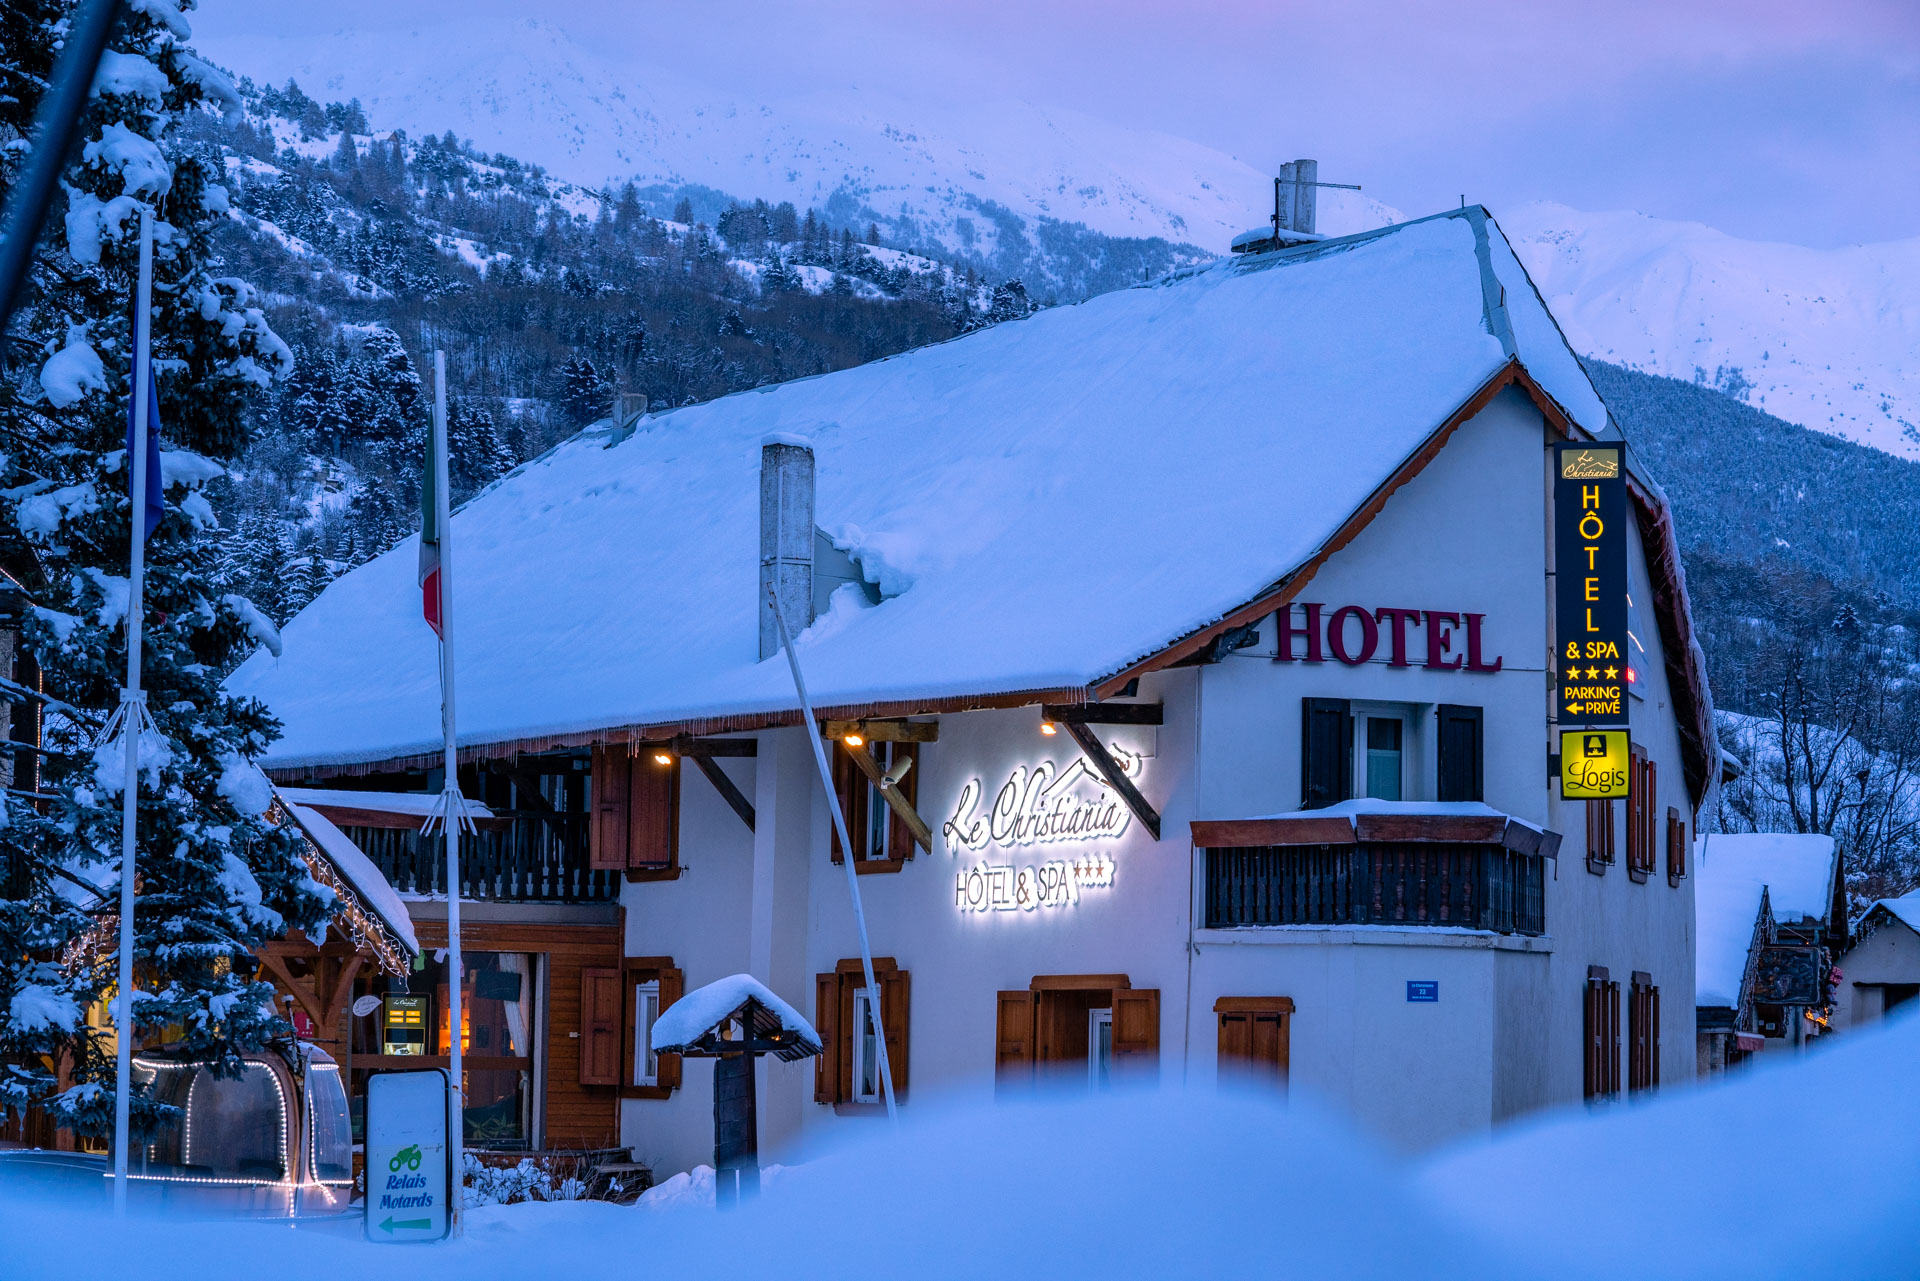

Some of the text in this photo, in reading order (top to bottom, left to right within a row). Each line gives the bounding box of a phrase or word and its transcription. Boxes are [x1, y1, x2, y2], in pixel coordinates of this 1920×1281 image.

[1577, 450, 1593, 462] Le
[1563, 463, 1614, 478] Christiania
[1579, 485, 1604, 632] HÔTEL
[1272, 602, 1503, 672] HOTEL
[1566, 641, 1620, 659] & SPA
[1565, 686, 1620, 699] PARKING
[1586, 699, 1620, 714] PRIVÉ
[1566, 759, 1625, 793] Logis
[943, 766, 1121, 848] Le Christiania
[956, 866, 1070, 906] HÔTEL & SPA
[386, 1173, 427, 1190] Relais
[379, 1192, 433, 1210] Motards
